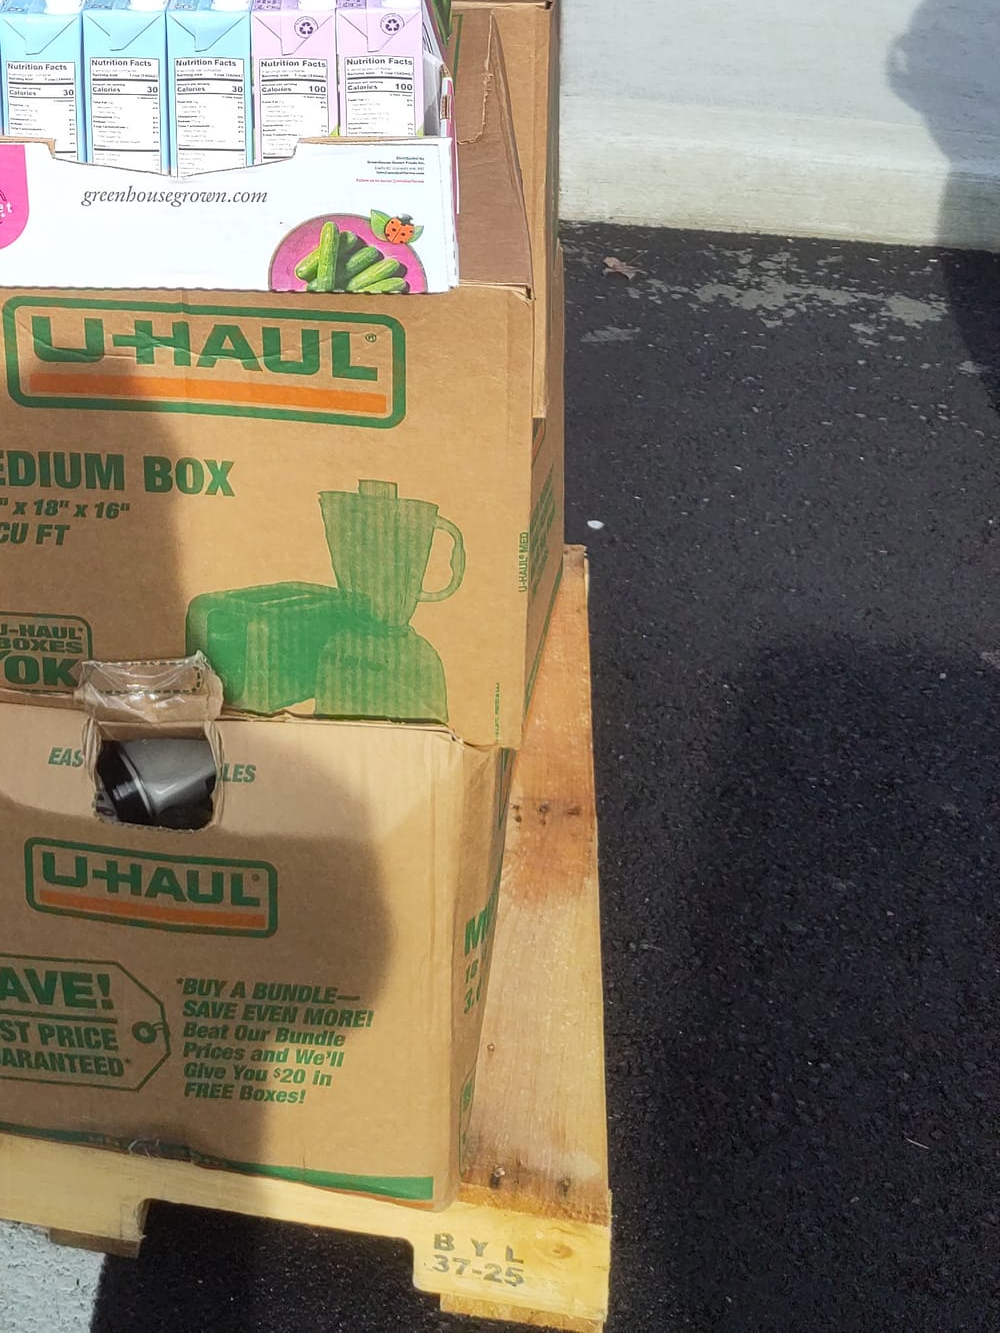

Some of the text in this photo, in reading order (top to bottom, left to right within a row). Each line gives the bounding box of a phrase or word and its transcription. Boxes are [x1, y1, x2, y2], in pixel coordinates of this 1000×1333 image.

[7, 62, 44, 70] Nutrition
[176, 58, 237, 67] Nutrition Facts
[260, 60, 327, 68] Nutrition Facts
[346, 58, 414, 66] Nutrition Facts
[80, 185, 268, 208] greenhousegrown.com
[142, 455, 236, 498] BOX
[12, 501, 28, 516] x
[34, 498, 70, 516] 18"
[73, 504, 88, 518] x
[94, 501, 131, 520] 16"
[35, 524, 71, 546] FT
[518, 532, 529, 554] MED
[4, 654, 80, 688] OK
[229, 980, 246, 999] A
[182, 1000, 374, 1028] SAVE EVEN MORE!
[38, 1022, 120, 1052] PRICE
[183, 1021, 346, 1048] Beat Our Bundle
[183, 1042, 346, 1068] Prices and We'll
[183, 1062, 333, 1086] Give You $20 in
[184, 1082, 306, 1104] FREE Boxes!
[432, 1254, 524, 1288] 37-25
